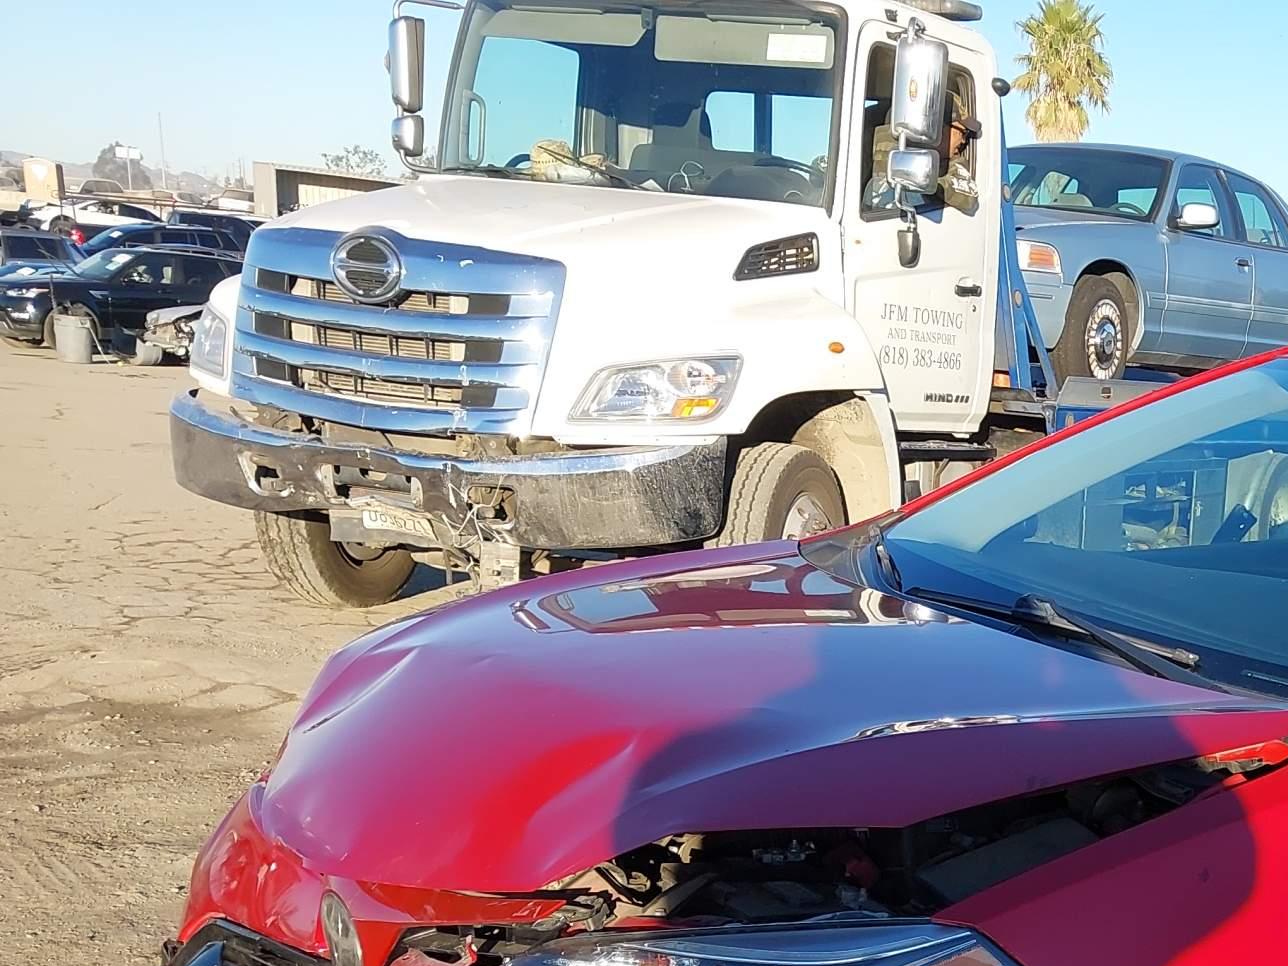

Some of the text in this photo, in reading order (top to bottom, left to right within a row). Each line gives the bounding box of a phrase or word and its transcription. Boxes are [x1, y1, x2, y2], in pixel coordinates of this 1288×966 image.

[881, 303, 963, 329] JFM TOWING
[887, 327, 957, 345] AND TRANSPORT
[879, 344, 961, 371] (818) 383-4866
